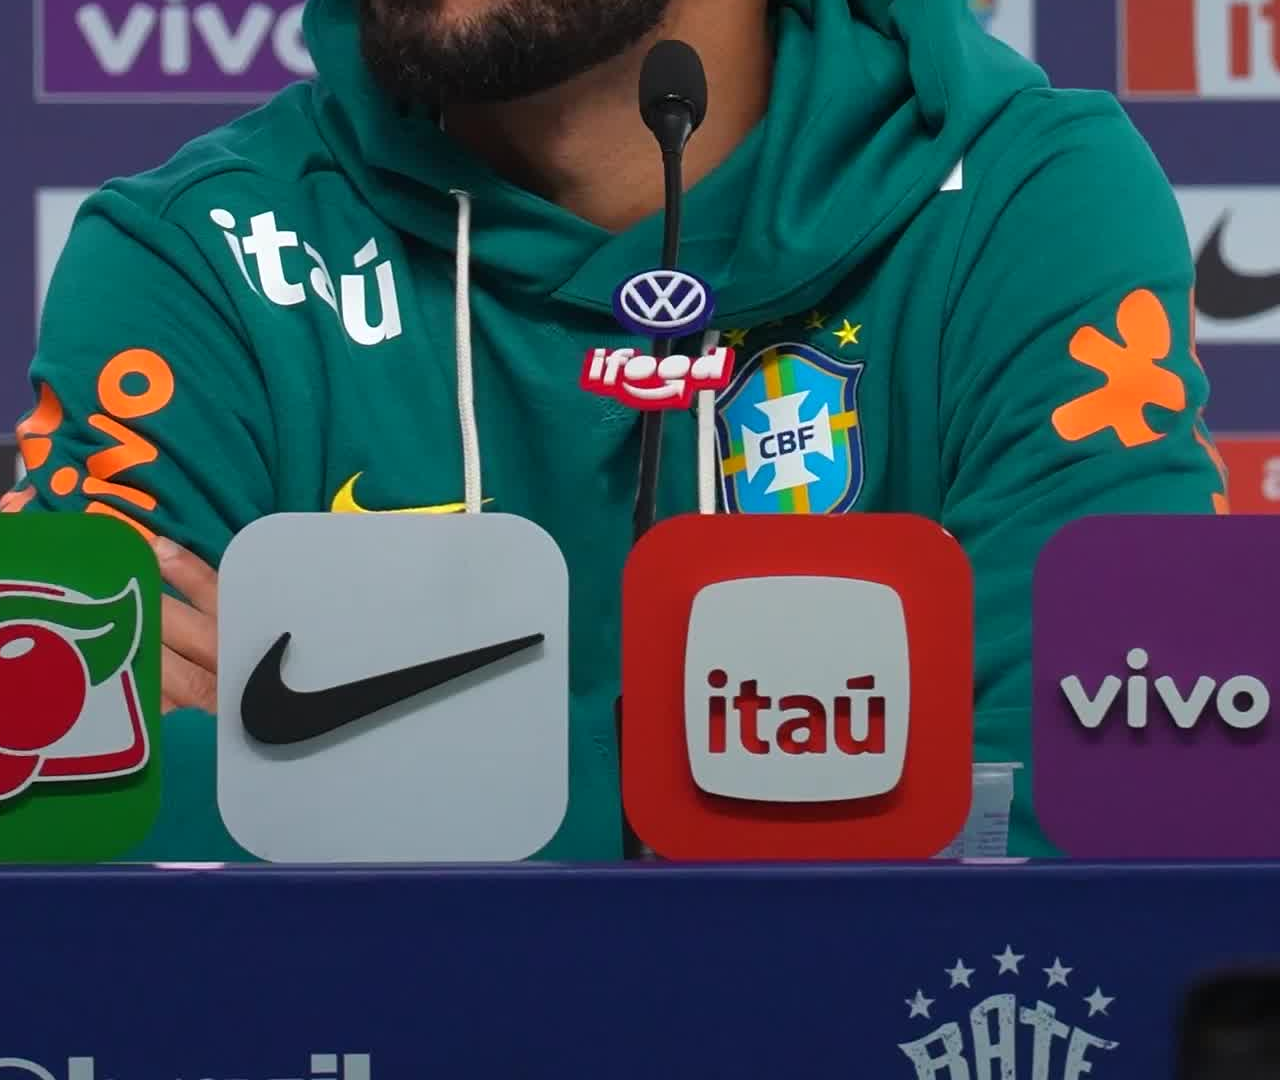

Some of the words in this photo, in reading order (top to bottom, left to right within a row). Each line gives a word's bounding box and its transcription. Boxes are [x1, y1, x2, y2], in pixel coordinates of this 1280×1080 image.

[589, 347, 724, 378] ifood
[759, 424, 815, 460] CBF
[706, 669, 886, 755] itaú
[1060, 647, 1270, 728] vivo
